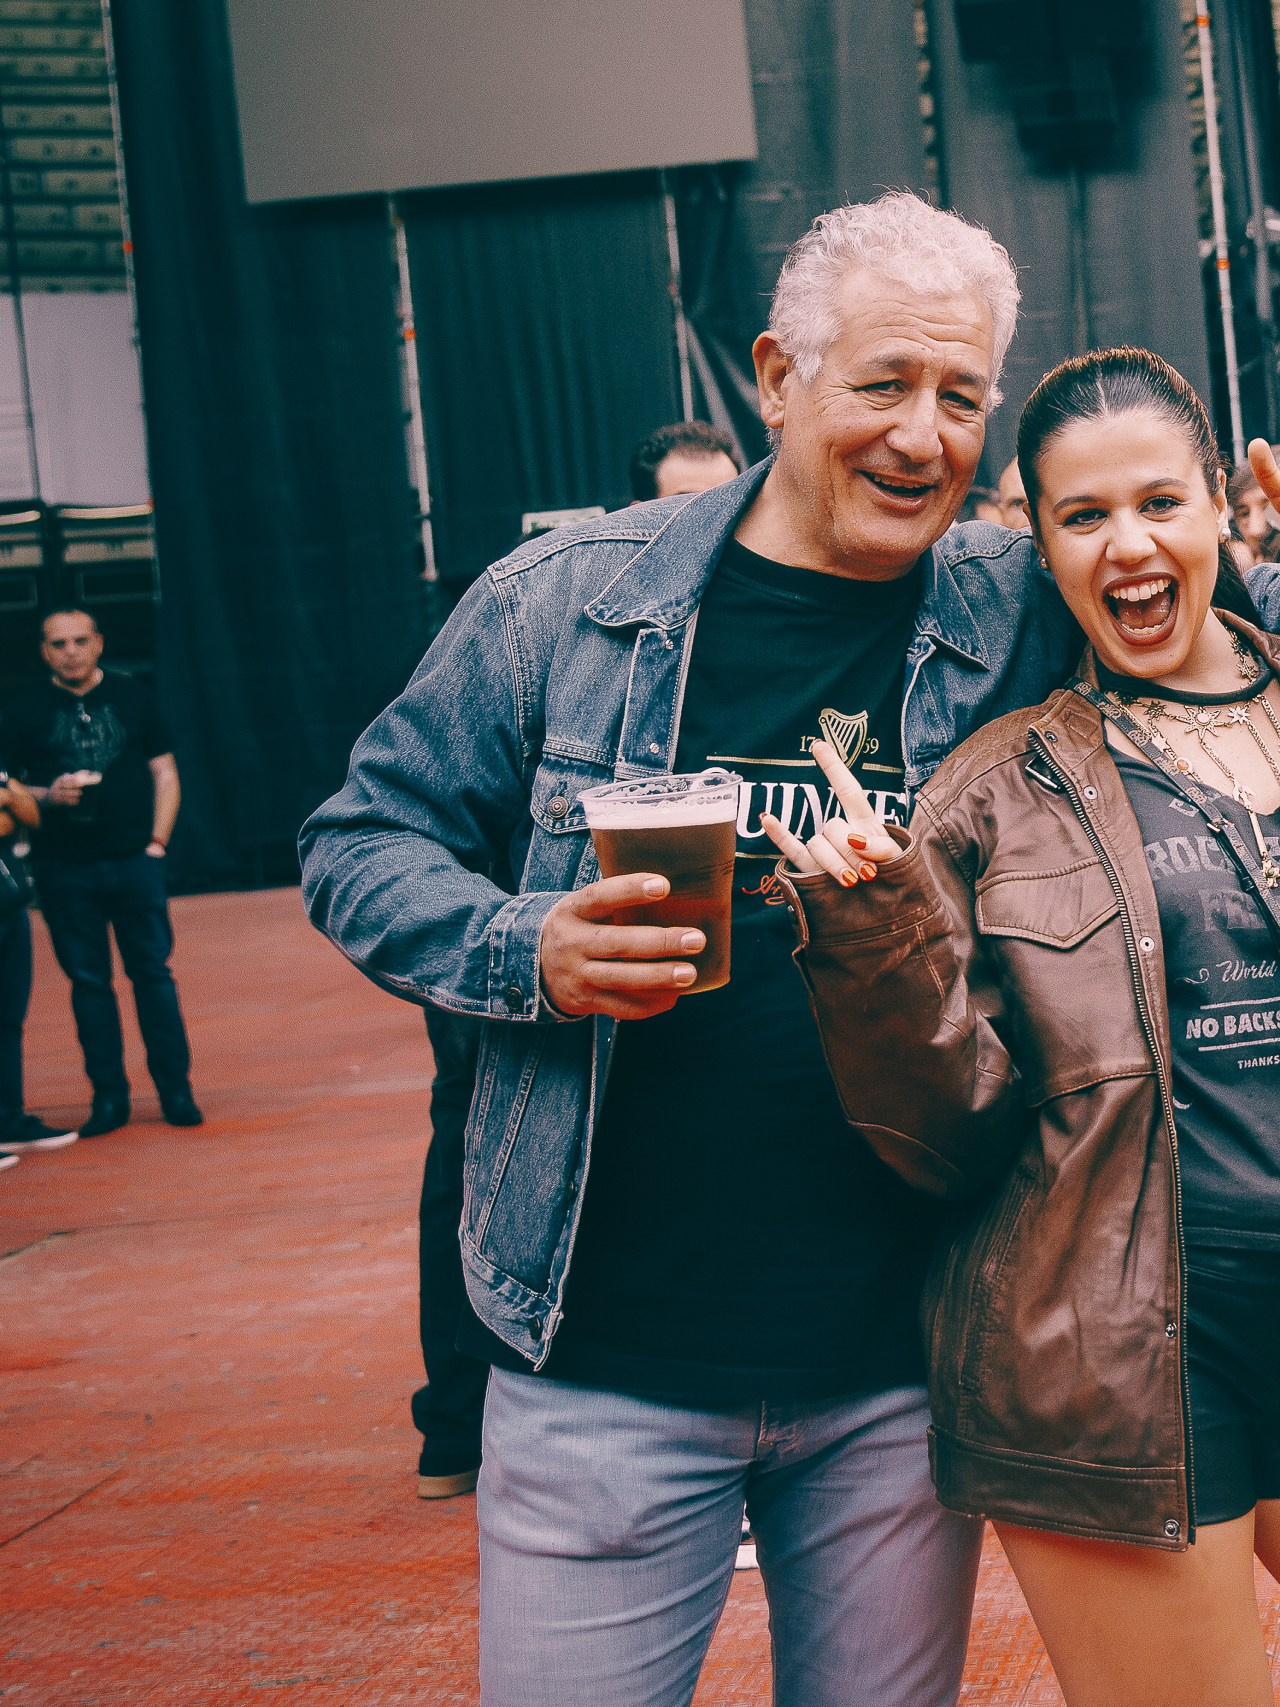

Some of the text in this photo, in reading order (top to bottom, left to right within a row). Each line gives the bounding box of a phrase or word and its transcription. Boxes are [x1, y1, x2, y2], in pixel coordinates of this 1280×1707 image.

[800, 735, 880, 754] 17 59
[1144, 835, 1242, 881] ROC
[1216, 959, 1277, 983] World
[1185, 1017, 1220, 1040] NO
[1237, 1054, 1280, 1070] THANKS
